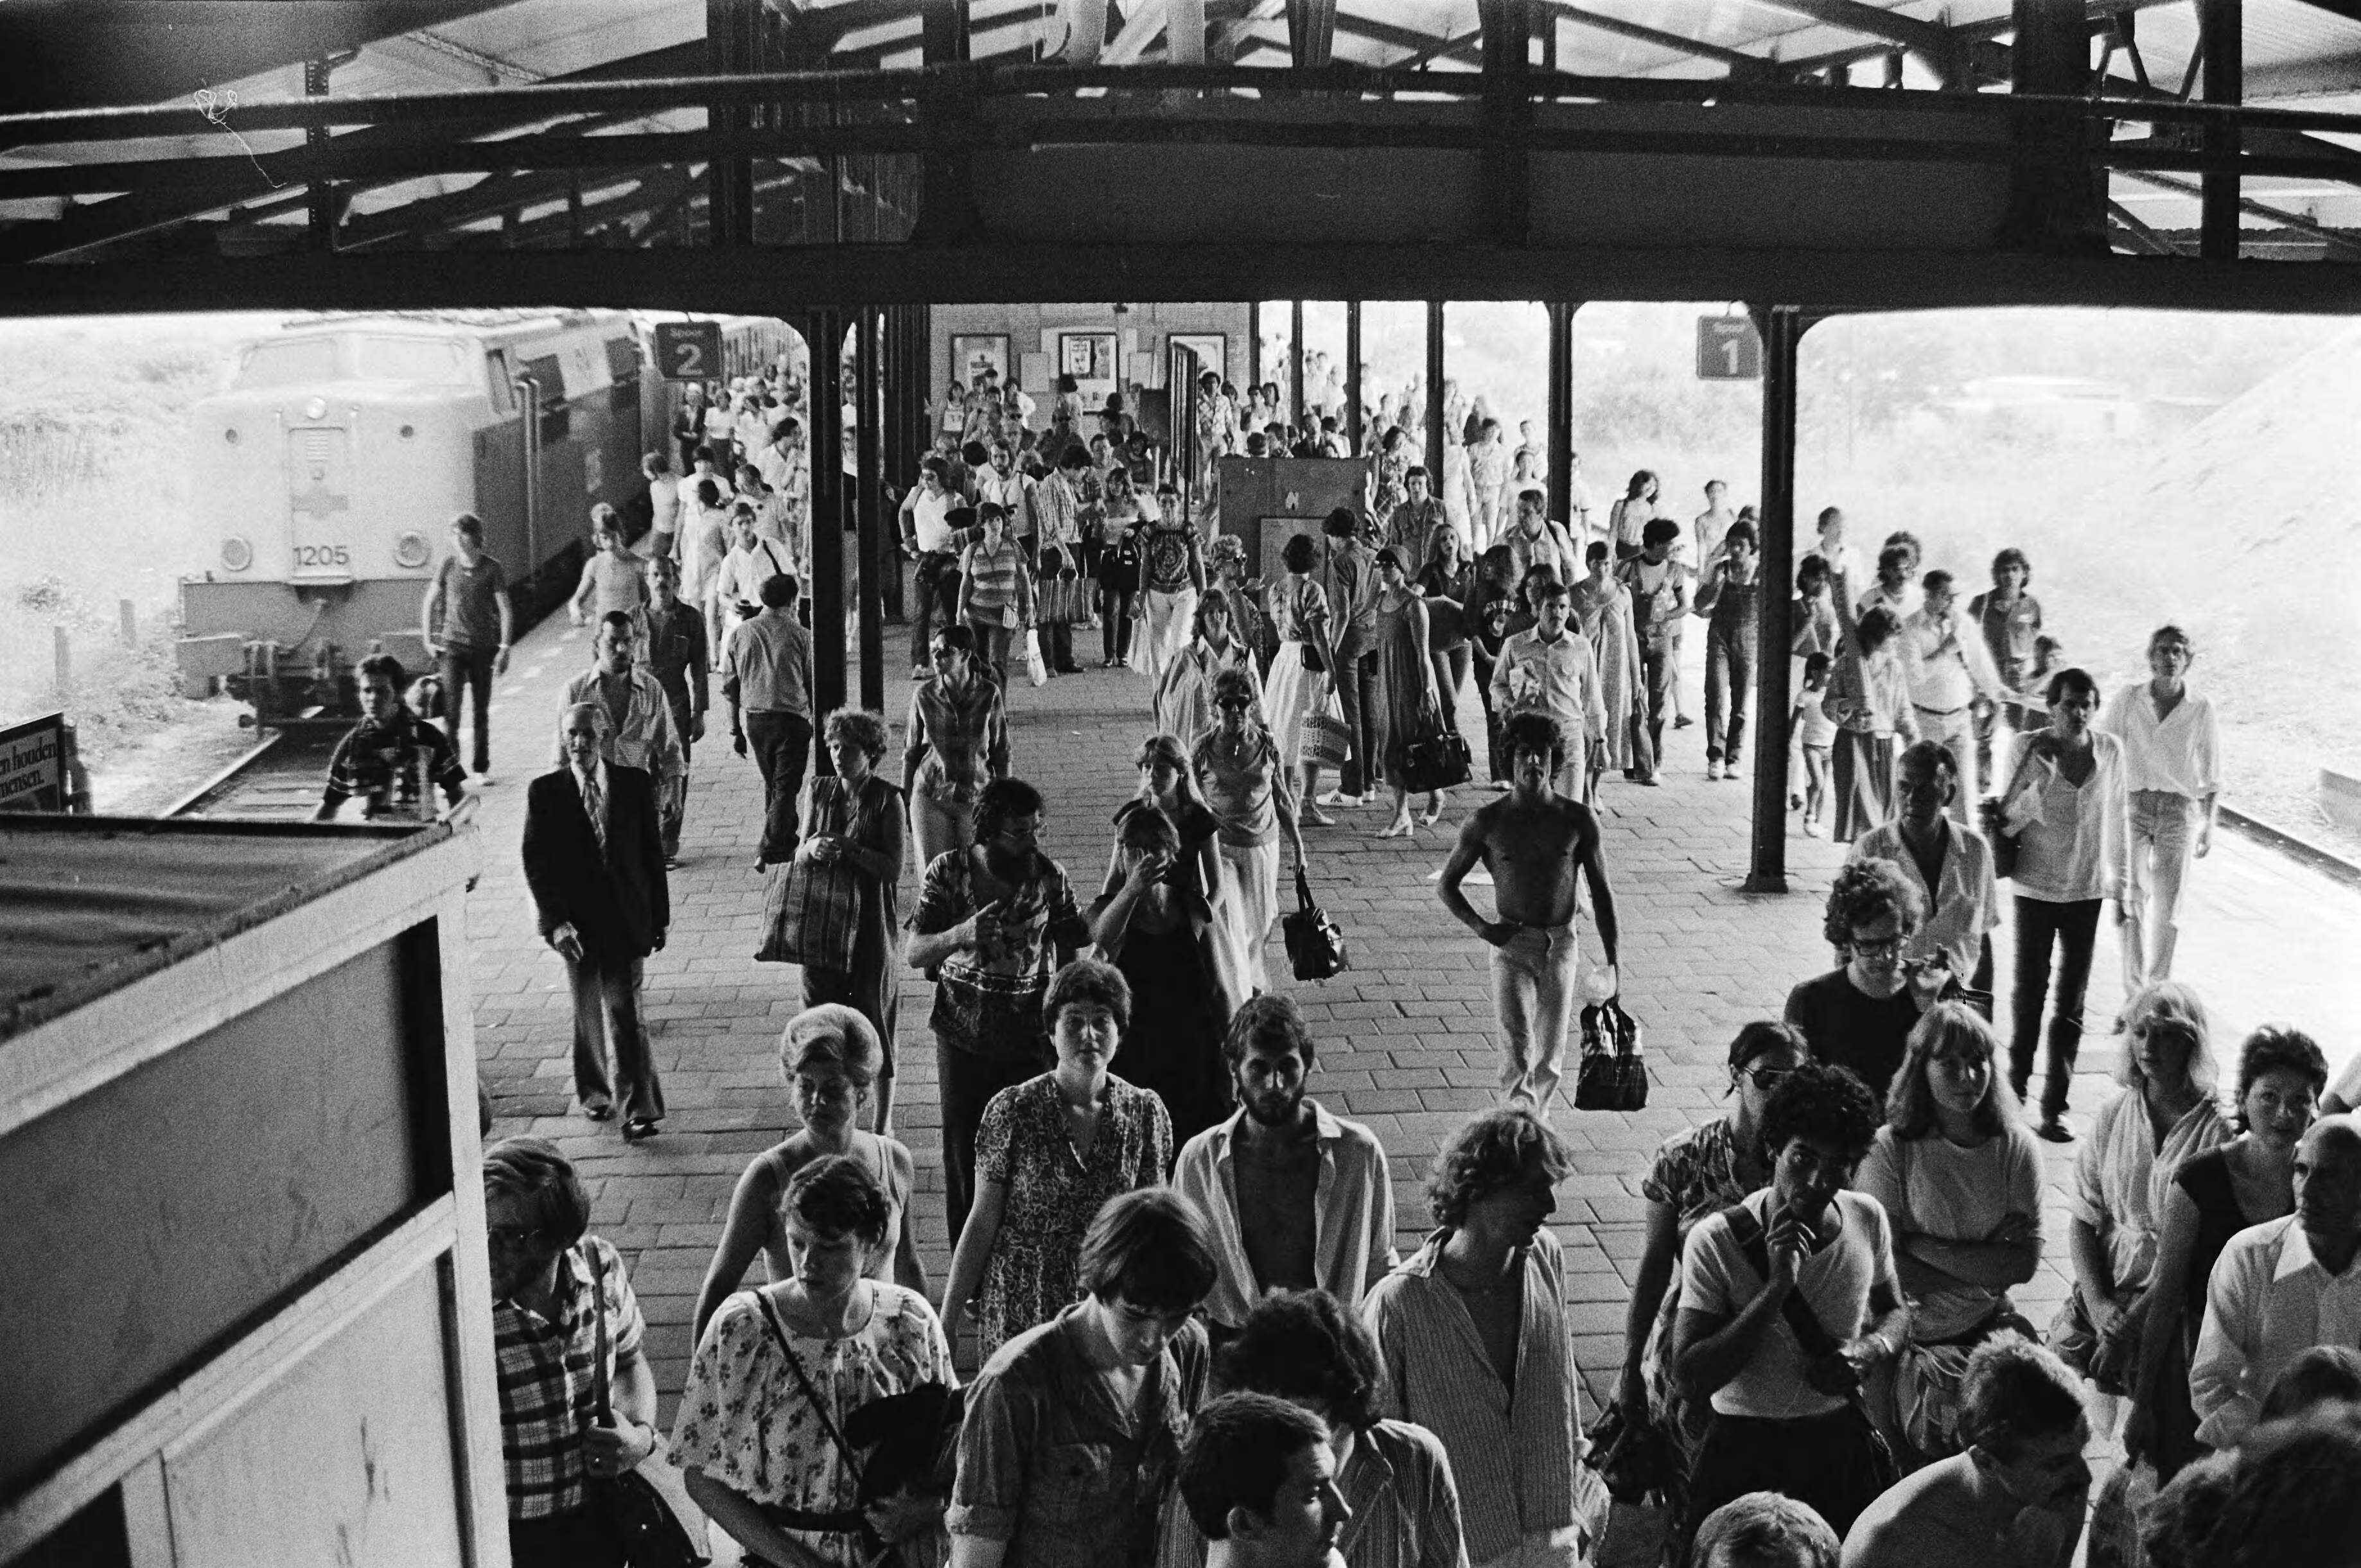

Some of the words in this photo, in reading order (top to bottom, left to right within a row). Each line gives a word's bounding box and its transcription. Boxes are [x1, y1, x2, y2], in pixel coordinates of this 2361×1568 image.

[675, 344, 703, 375] 2
[1722, 339, 1738, 374] 1
[293, 545, 349, 566] 1205
[13, 736, 57, 771] houden
